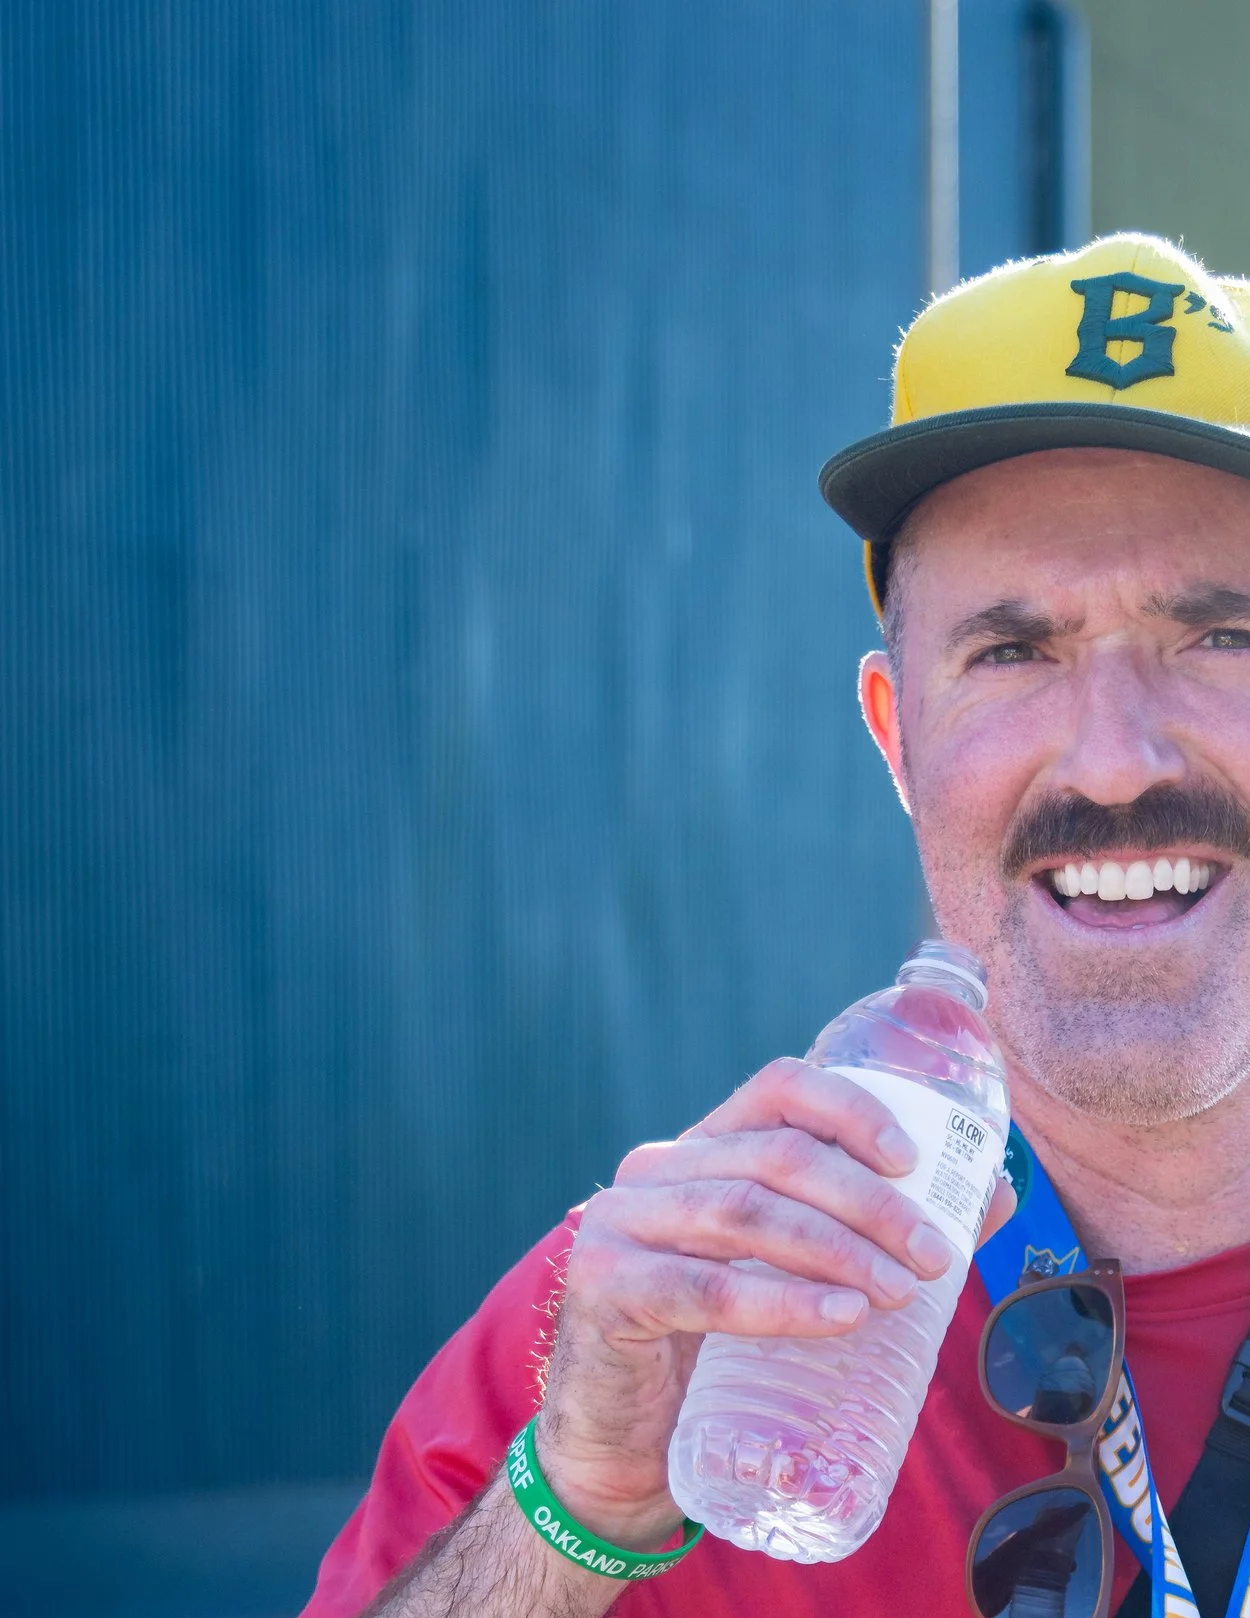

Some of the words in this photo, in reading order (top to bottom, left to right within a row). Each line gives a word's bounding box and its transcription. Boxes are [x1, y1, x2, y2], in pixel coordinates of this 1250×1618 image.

[951, 1115, 964, 1134] CA
[966, 1123, 985, 1146] CRV
[534, 1506, 626, 1575] OAKLAND
